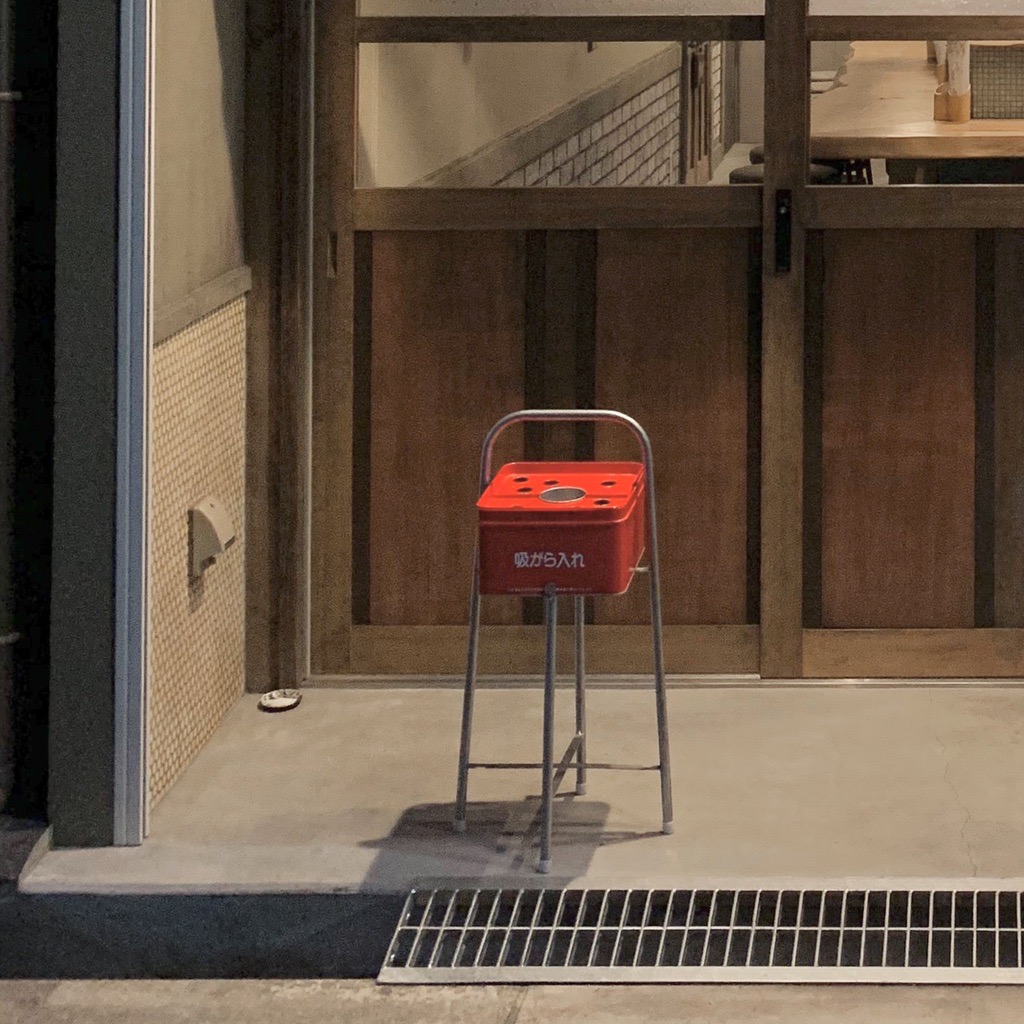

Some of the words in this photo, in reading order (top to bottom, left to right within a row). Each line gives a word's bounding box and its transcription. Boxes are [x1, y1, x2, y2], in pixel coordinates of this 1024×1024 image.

[514, 551, 586, 569] 吸がら入れ
